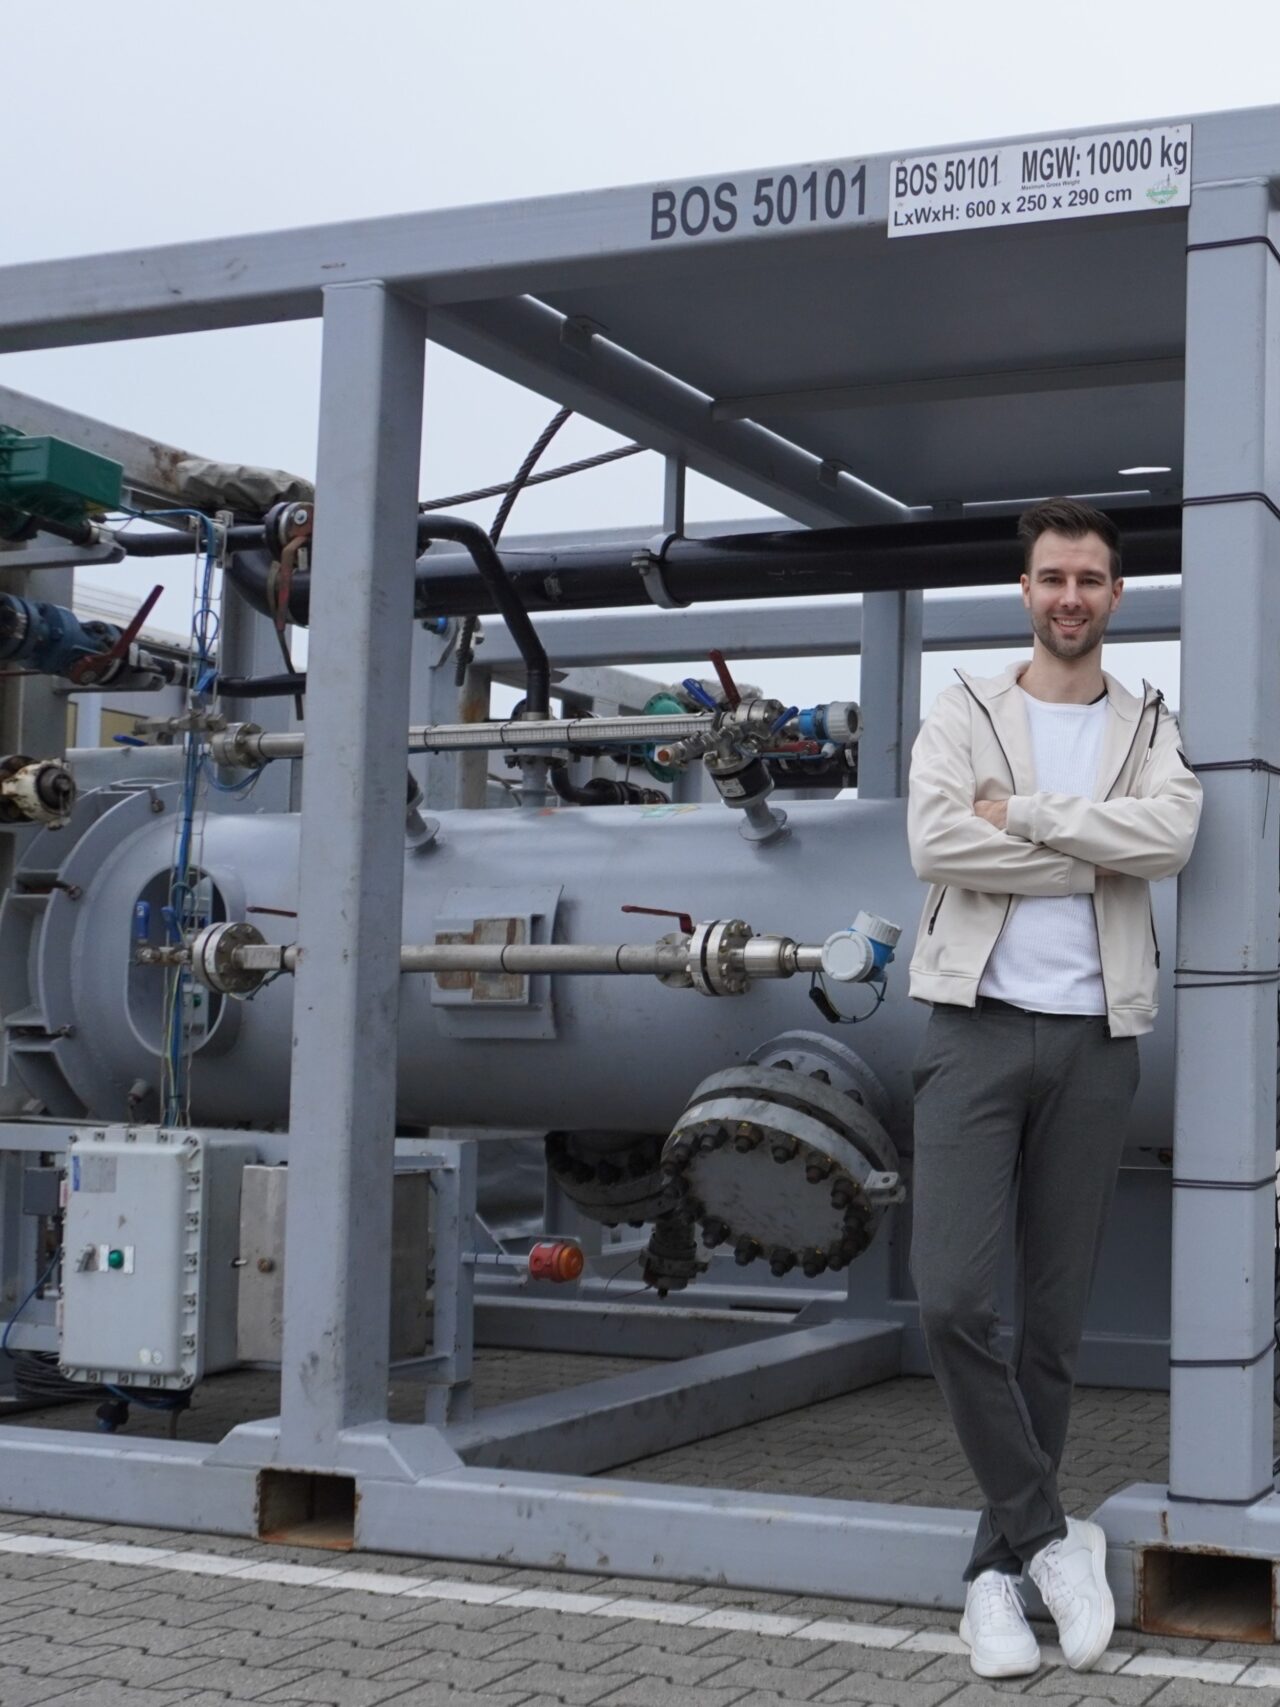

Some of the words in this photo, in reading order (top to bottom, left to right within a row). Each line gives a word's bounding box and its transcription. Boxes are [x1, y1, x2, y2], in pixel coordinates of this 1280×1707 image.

[895, 162, 937, 198] BOS
[944, 154, 999, 192] 50101
[1021, 145, 1080, 183] MGW:
[1086, 137, 1152, 175] 10000
[1160, 135, 1187, 175] kg
[1021, 183, 1045, 191] Maximum
[1062, 179, 1080, 187] Weight
[651, 182, 737, 240] BOS
[753, 165, 866, 227] 50101
[894, 204, 960, 227] LxWxH:
[966, 200, 996, 218] 600
[1001, 201, 1011, 214] x
[1016, 194, 1047, 213] 250
[1053, 195, 1063, 209] x
[1068, 187, 1099, 207] 290
[1105, 187, 1132, 203] cm
